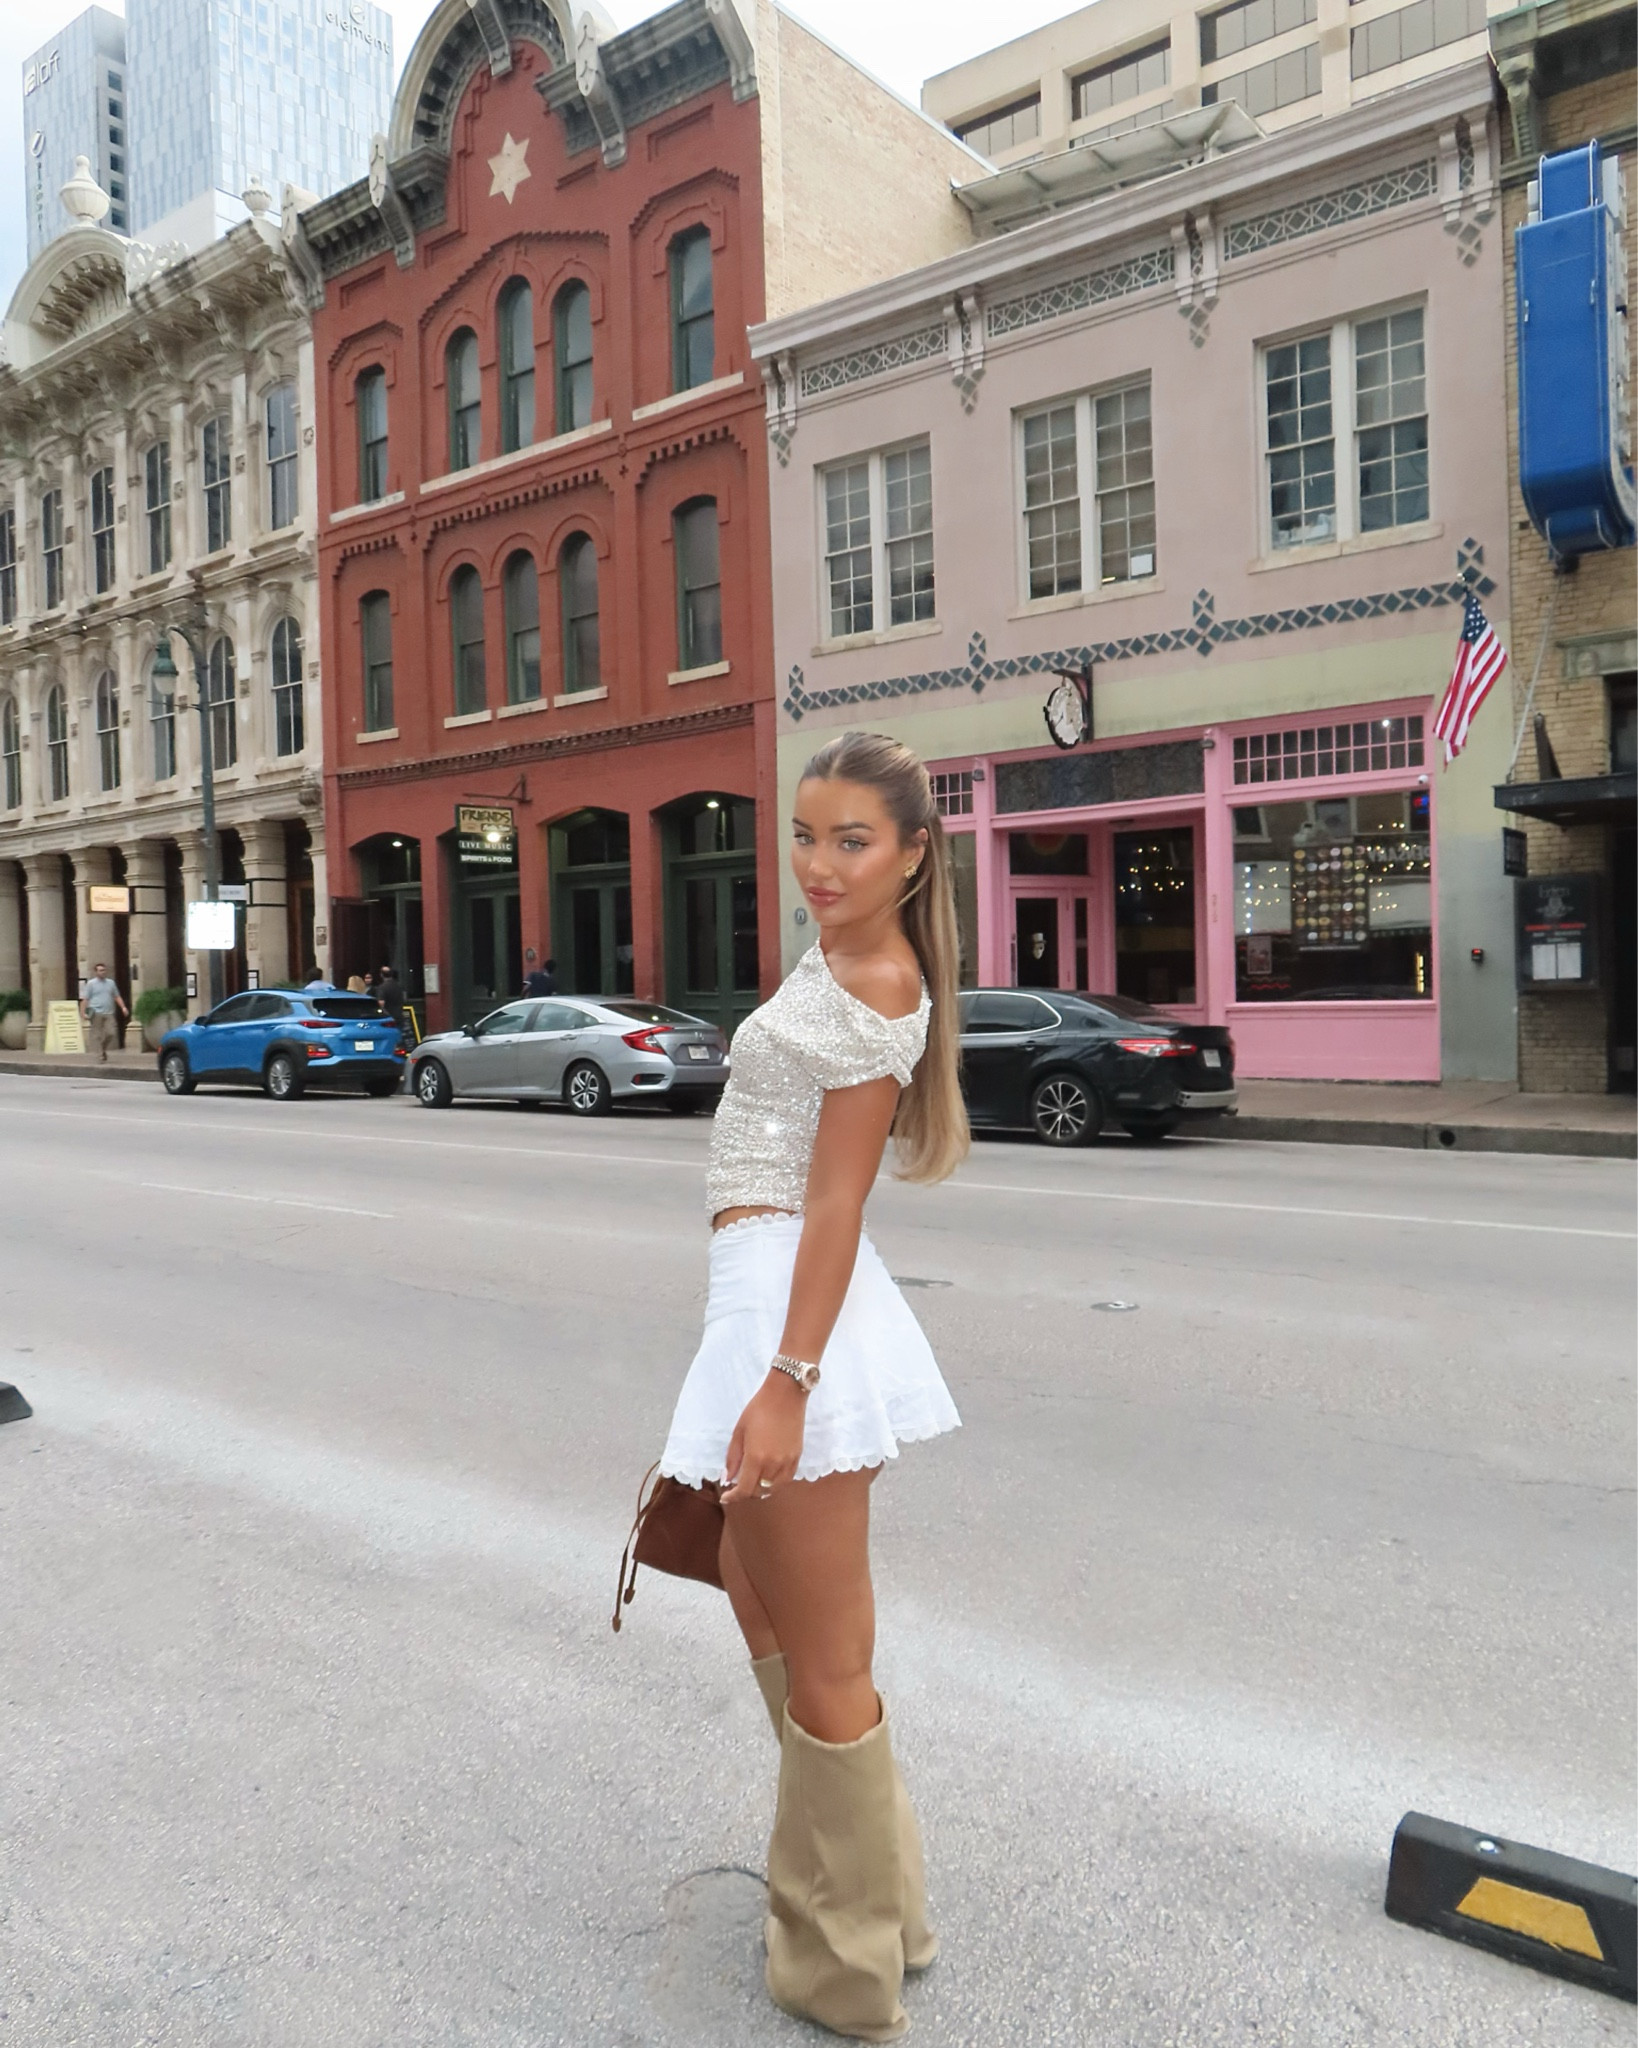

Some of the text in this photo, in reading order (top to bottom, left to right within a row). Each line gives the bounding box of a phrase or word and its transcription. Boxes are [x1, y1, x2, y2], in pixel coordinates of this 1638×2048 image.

[325, 10, 390, 55] element
[462, 809, 511, 823] FRIENDS
[461, 841, 512, 850] LIVE MUSIC
[461, 854, 487, 862] SPIRITS
